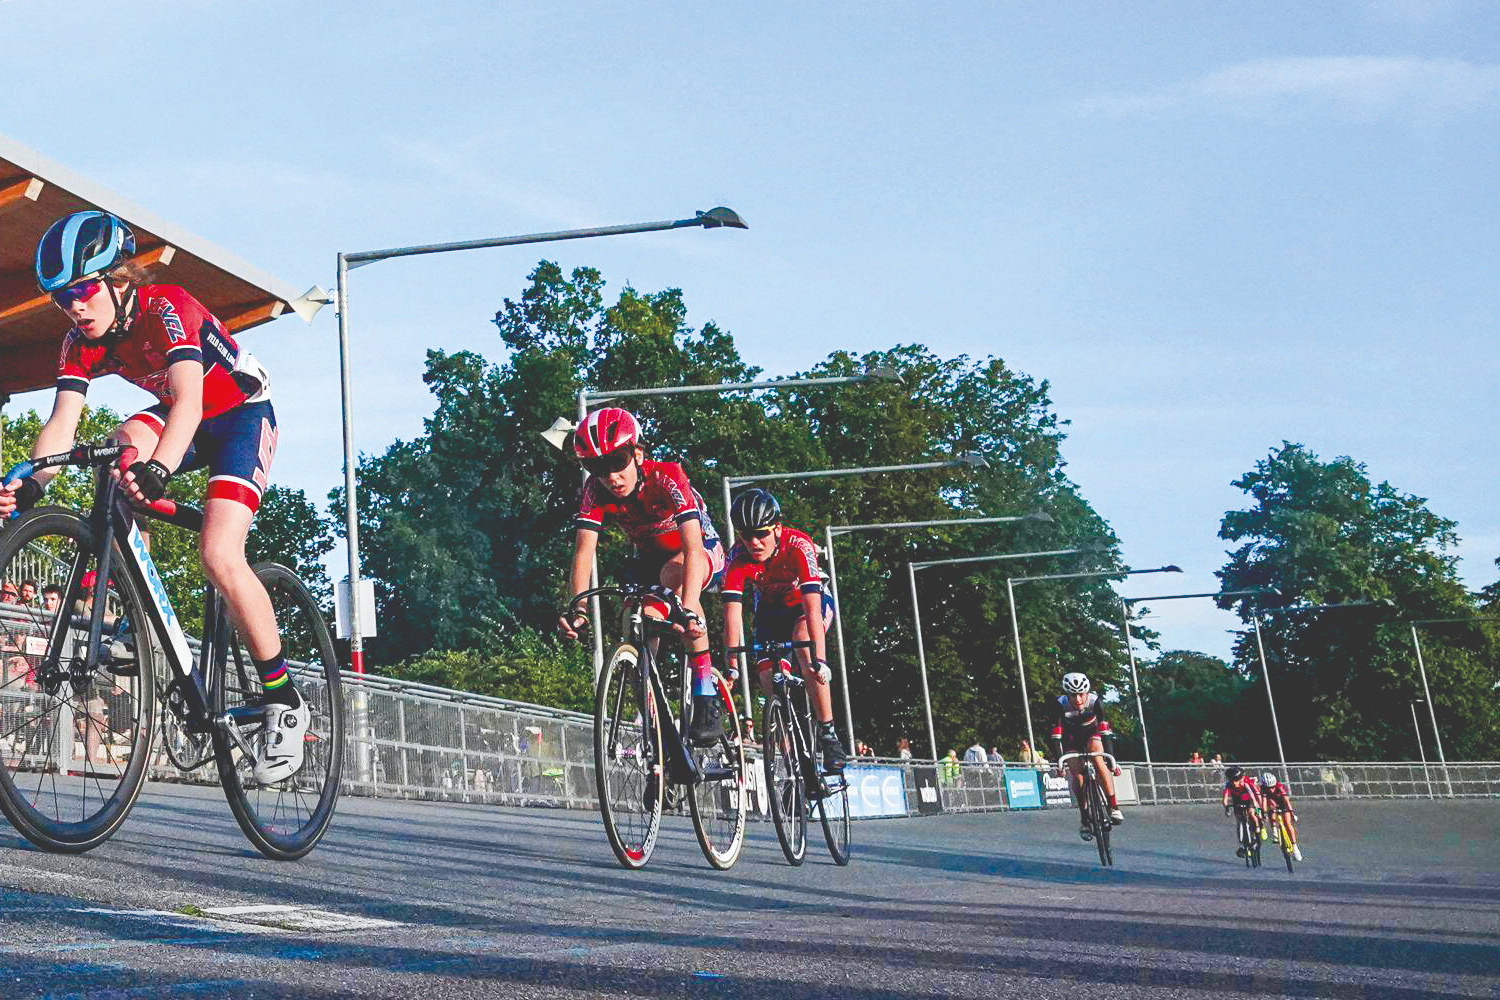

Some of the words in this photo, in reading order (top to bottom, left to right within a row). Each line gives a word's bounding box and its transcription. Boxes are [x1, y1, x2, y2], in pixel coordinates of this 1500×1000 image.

[207, 332, 220, 347] VELO
[94, 446, 119, 457] WORX
[46, 453, 70, 464] WORX
